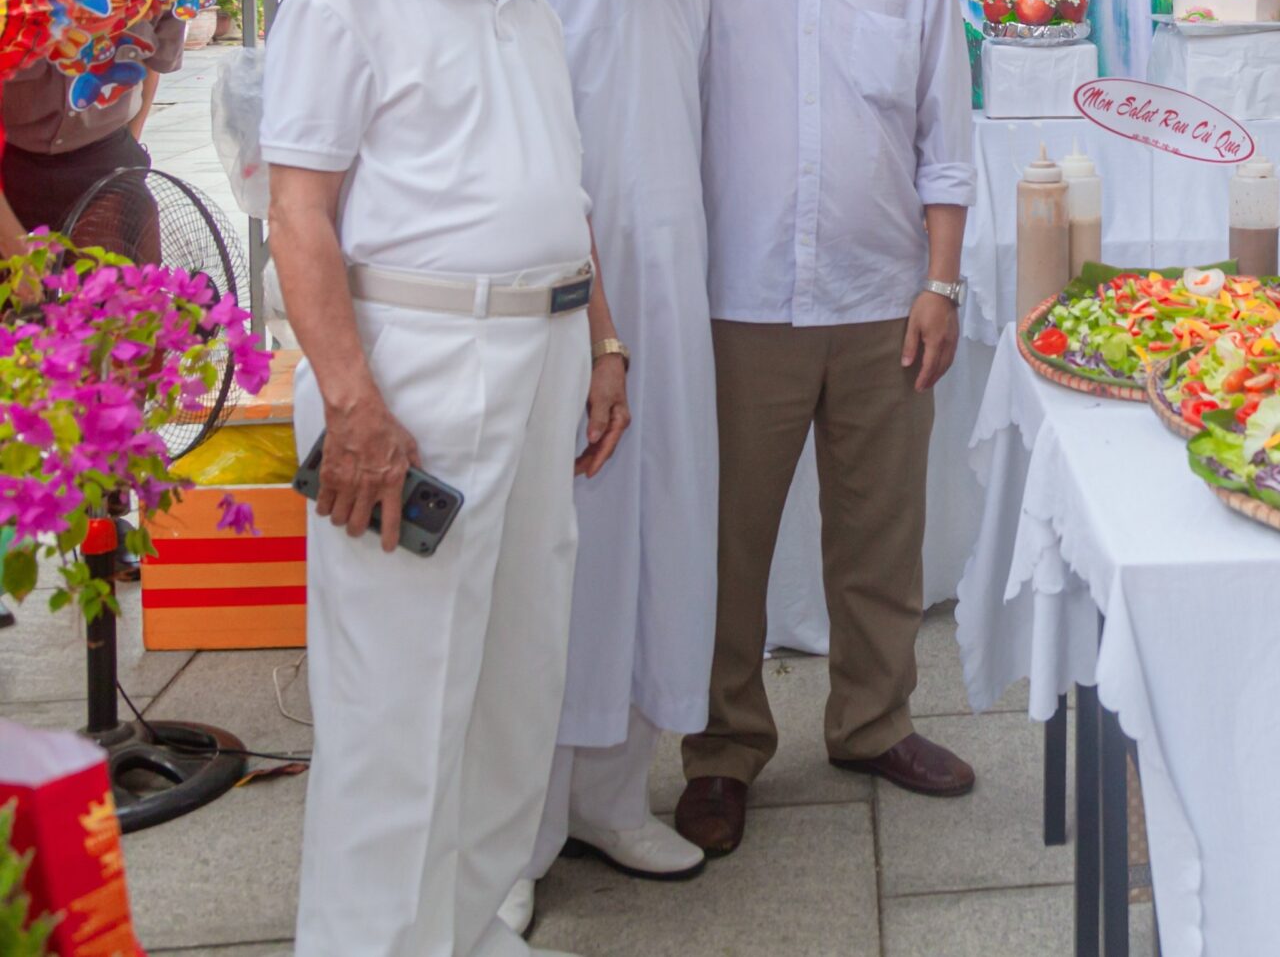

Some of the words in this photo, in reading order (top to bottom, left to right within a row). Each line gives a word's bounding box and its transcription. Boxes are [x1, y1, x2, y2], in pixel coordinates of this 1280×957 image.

[1082, 87, 1114, 112] Món
[1159, 109, 1189, 134] Rau
[1192, 121, 1217, 143] Củ
[1213, 130, 1246, 158] Quả
